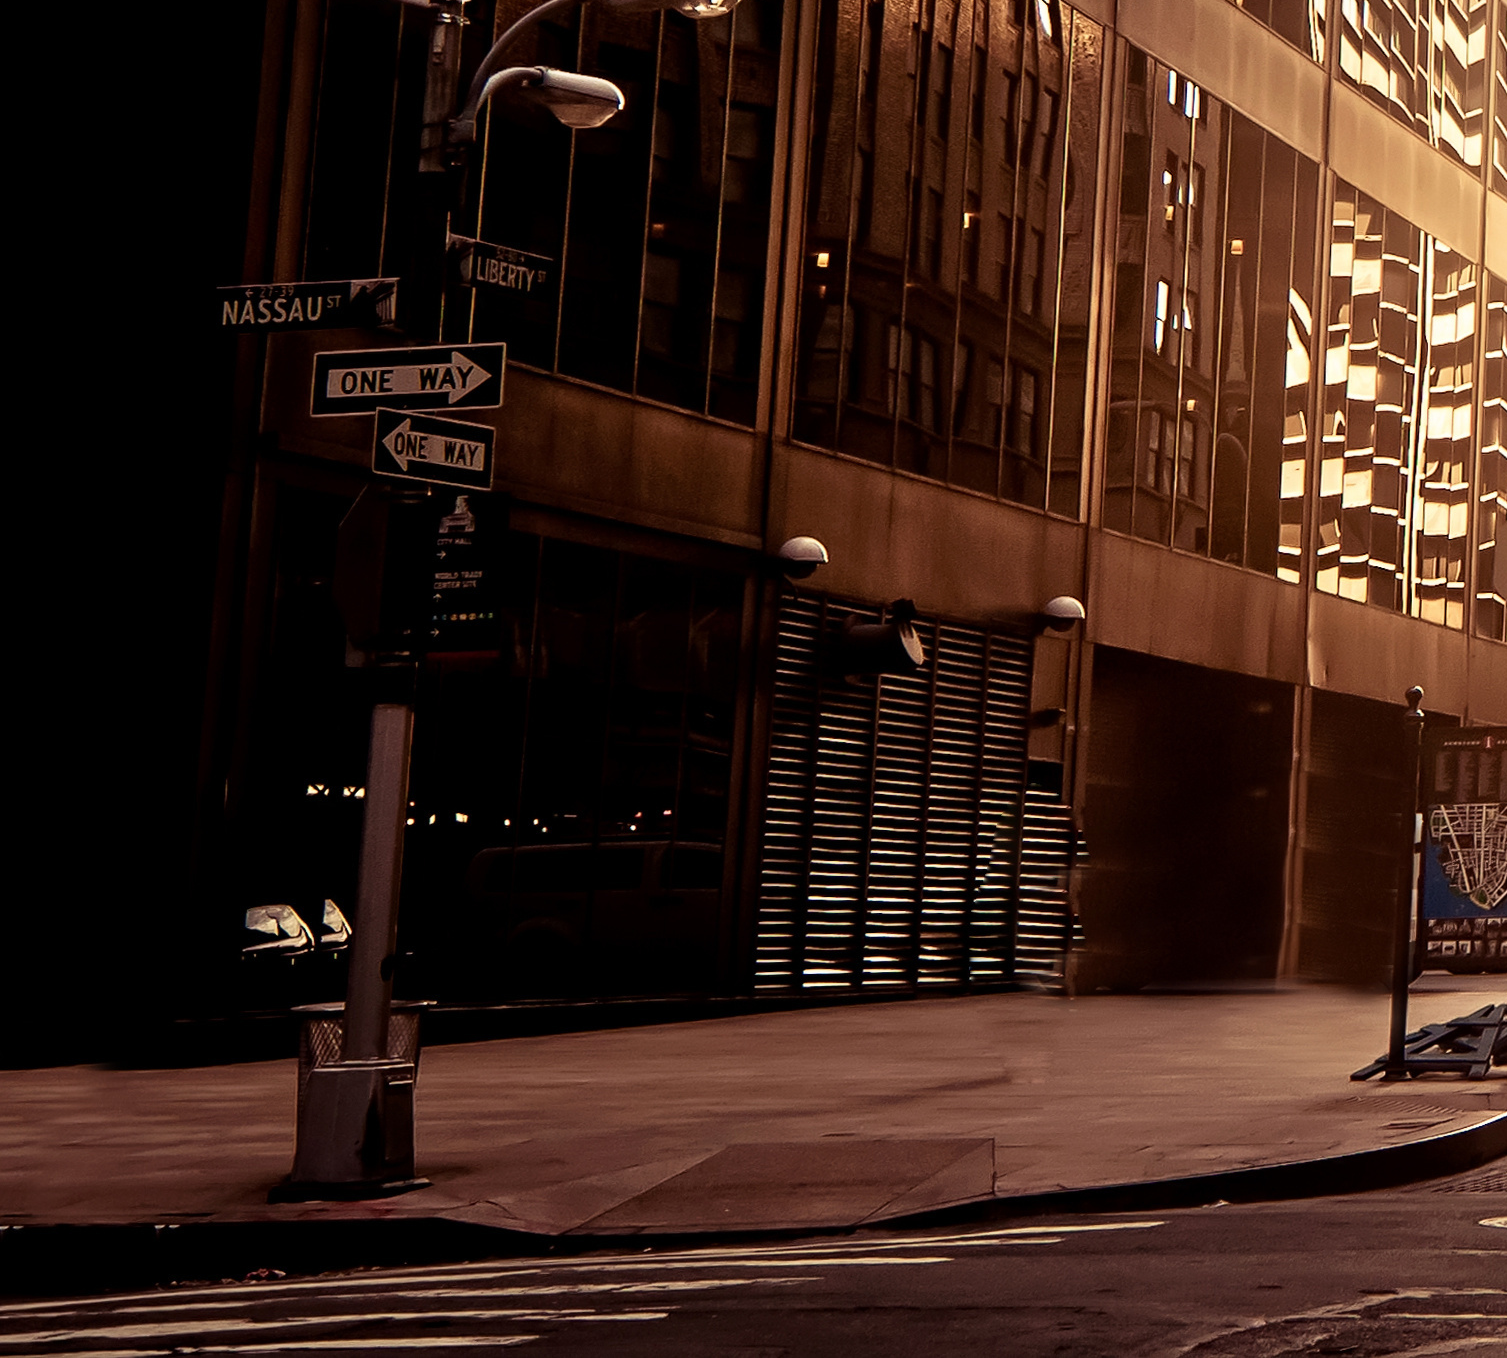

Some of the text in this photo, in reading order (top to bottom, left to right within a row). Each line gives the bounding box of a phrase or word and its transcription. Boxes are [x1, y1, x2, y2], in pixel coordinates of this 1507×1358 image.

[476, 255, 535, 292] LIBERTY
[221, 294, 342, 326] NASSAU ST
[340, 365, 474, 394] ONE WAY
[394, 432, 479, 467] ONE WAY
